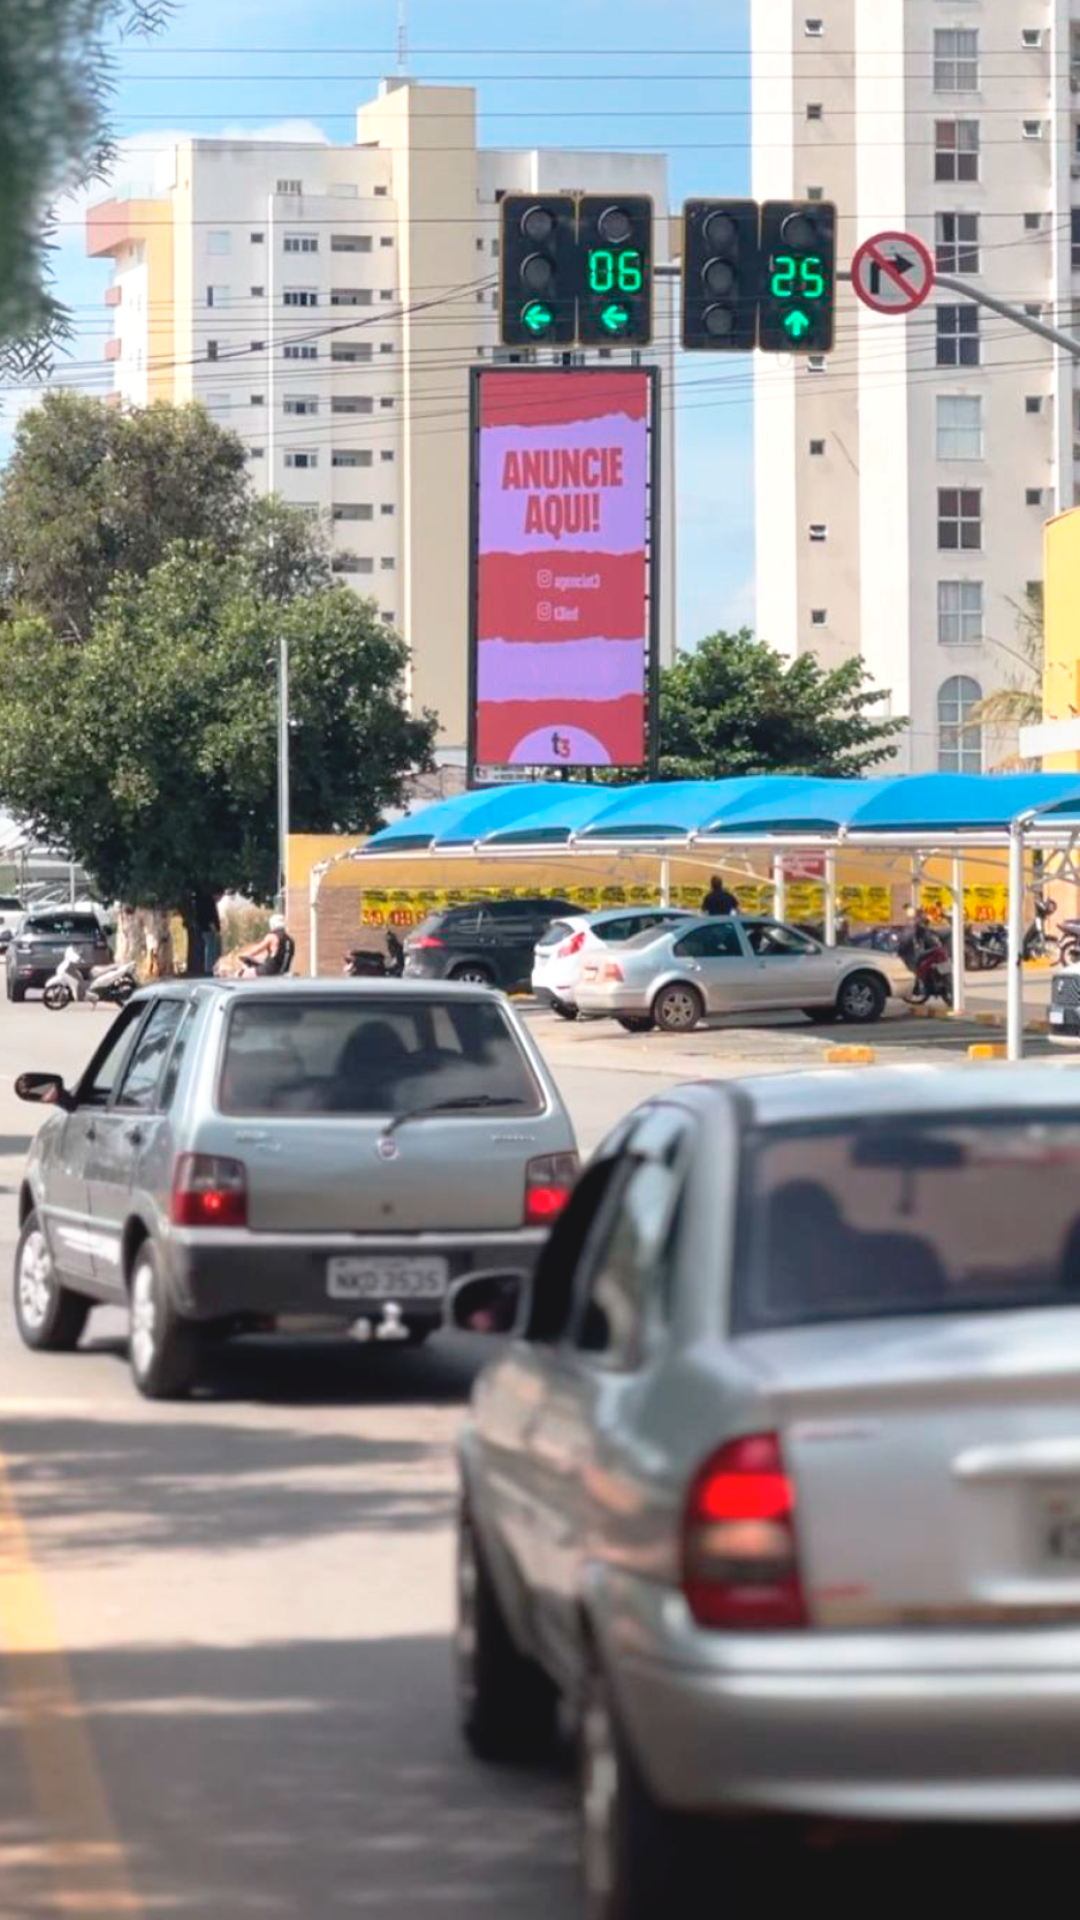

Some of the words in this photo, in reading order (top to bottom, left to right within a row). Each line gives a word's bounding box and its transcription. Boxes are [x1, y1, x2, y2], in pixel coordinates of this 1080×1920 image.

[590, 251, 641, 291] 06
[772, 257, 823, 297] 25
[502, 447, 623, 490] ANUNCIE
[524, 493, 600, 540] AQUI!
[551, 732, 570, 758] t3
